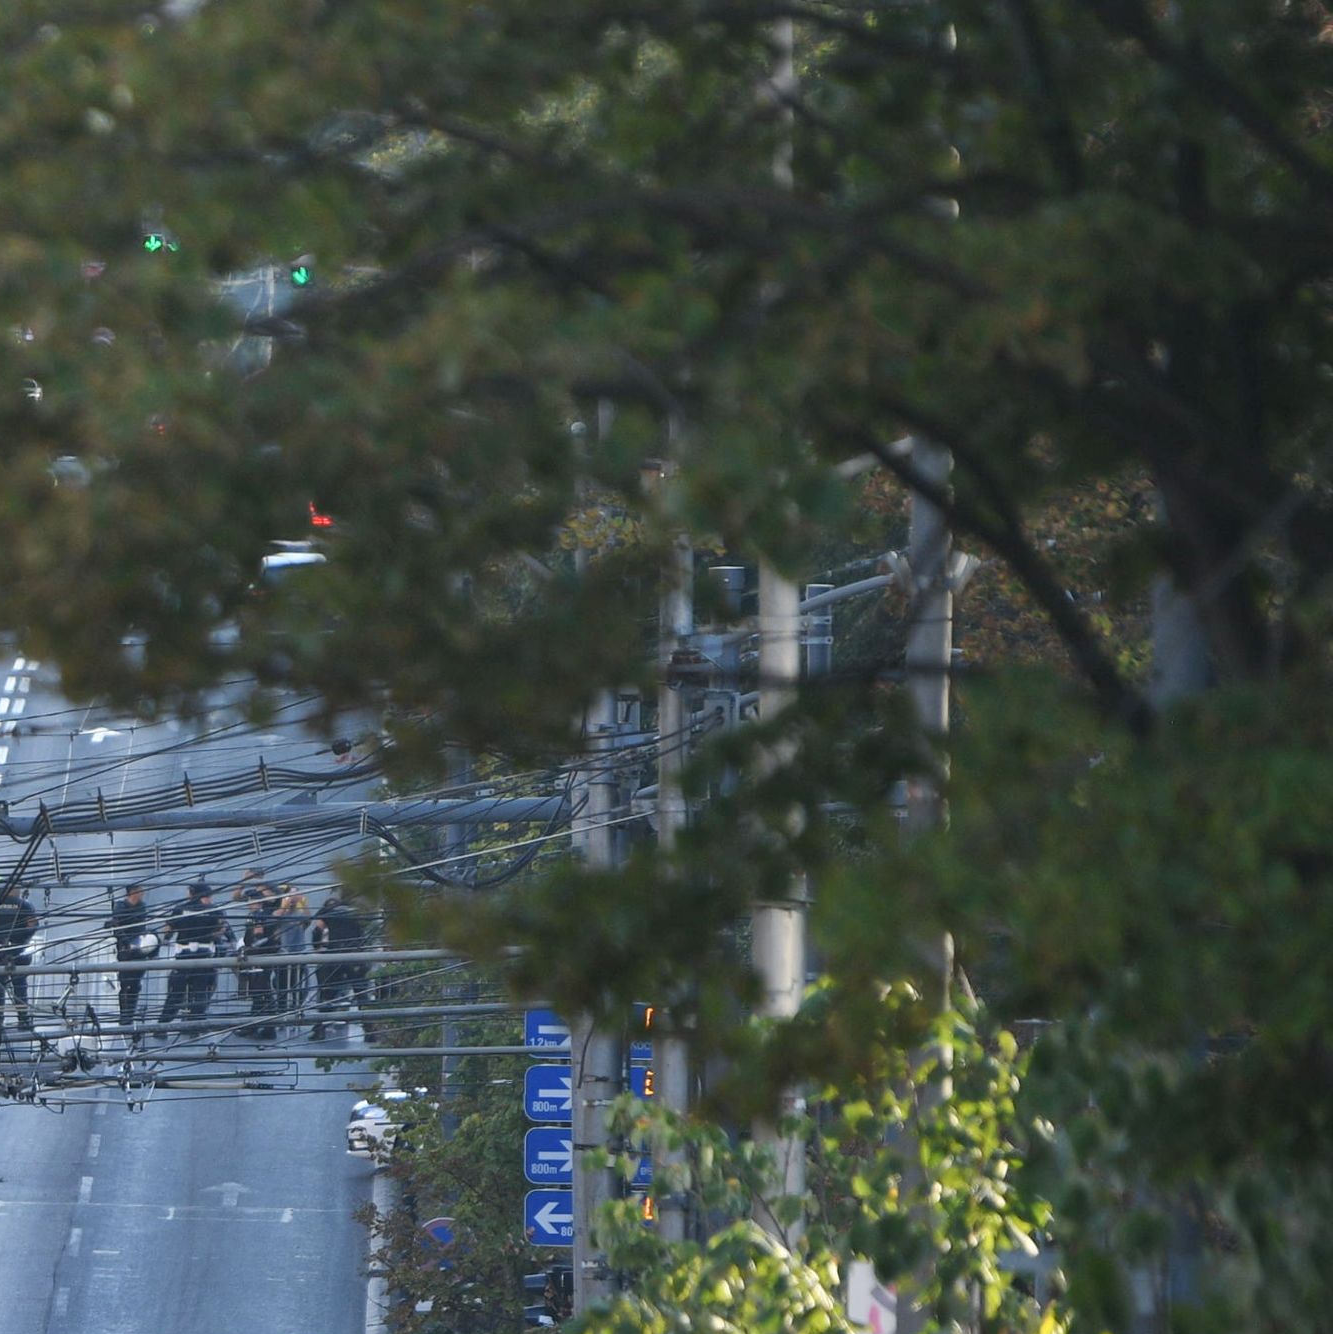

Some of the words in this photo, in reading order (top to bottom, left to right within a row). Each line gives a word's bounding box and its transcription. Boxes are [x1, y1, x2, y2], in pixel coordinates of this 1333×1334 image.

[532, 1101, 558, 1113] 800m
[531, 1163, 558, 1175] 800m
[560, 1226, 573, 1238] 80
